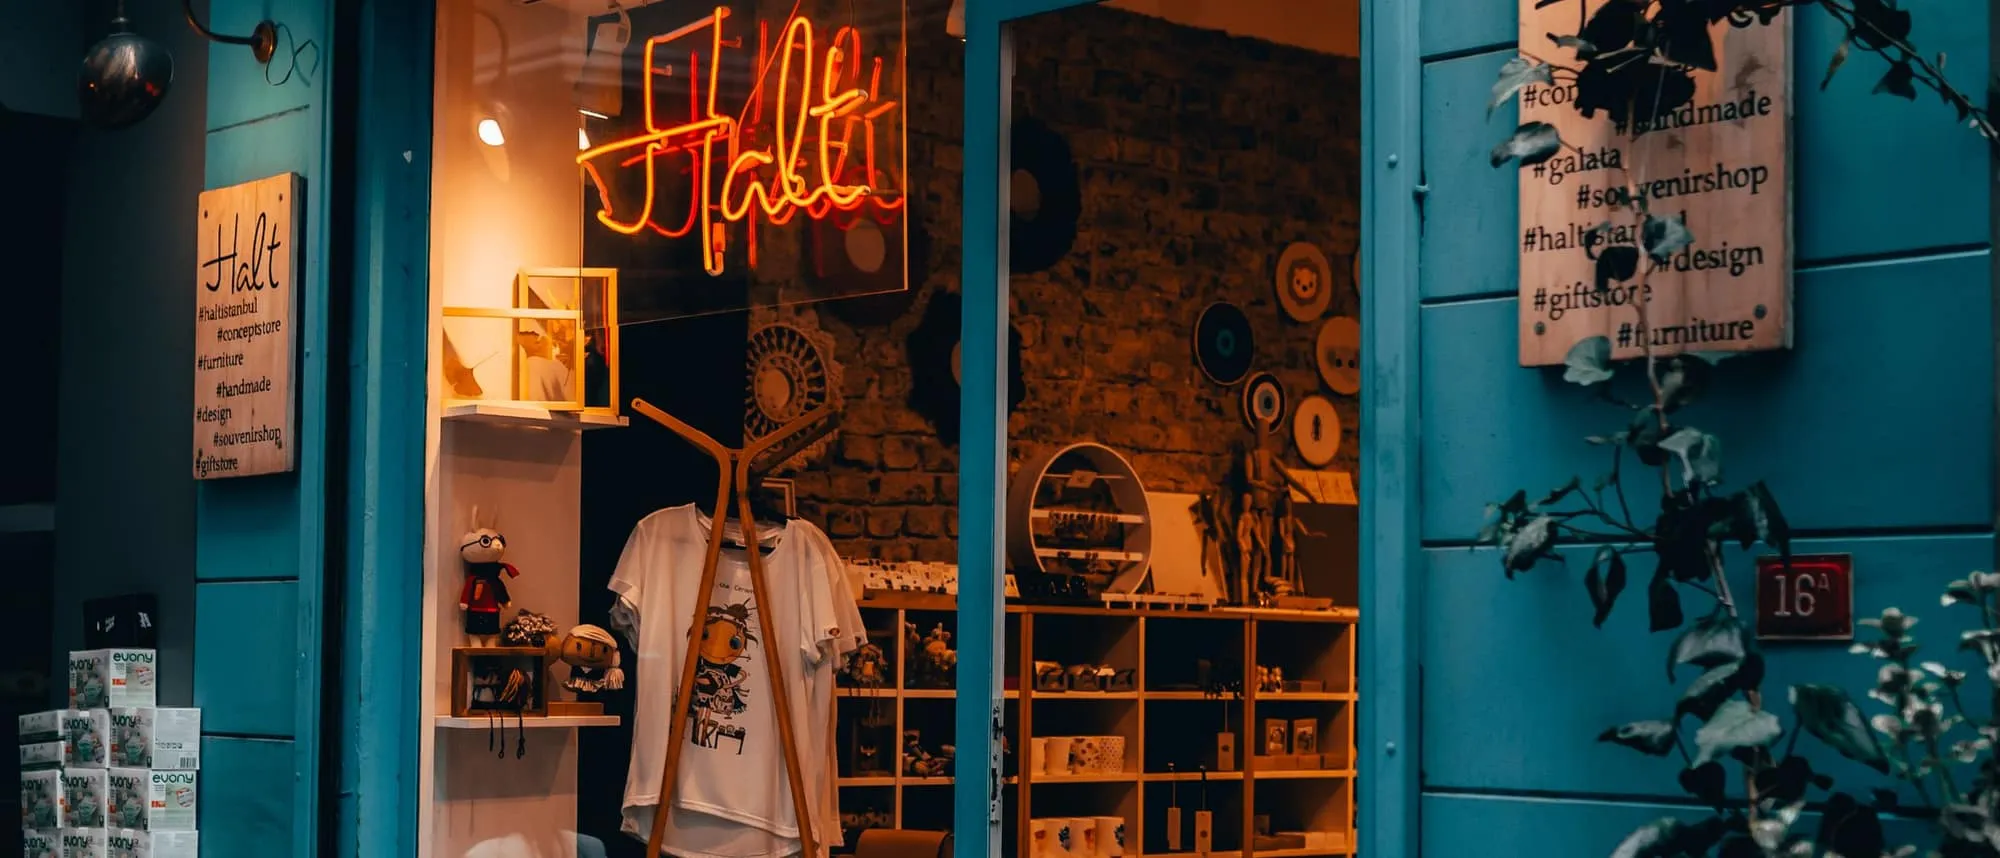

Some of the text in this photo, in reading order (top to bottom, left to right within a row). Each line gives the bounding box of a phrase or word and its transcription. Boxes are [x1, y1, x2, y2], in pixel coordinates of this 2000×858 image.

[576, 7, 872, 275] Halt
[1533, 146, 1622, 185] #galata
[1577, 162, 1769, 210] #sovenirshop
[203, 212, 281, 294] Halt
[199, 297, 258, 322] #haltistanbul
[217, 318, 281, 343] #conceptstore
[197, 351, 244, 371] #furniture
[216, 376, 271, 398] #handmade
[196, 406, 232, 426] #design
[213, 425, 281, 448] #souvenirshop
[196, 456, 238, 477] #giftstore
[112, 652, 153, 663] evony
[152, 773, 194, 784] evony
